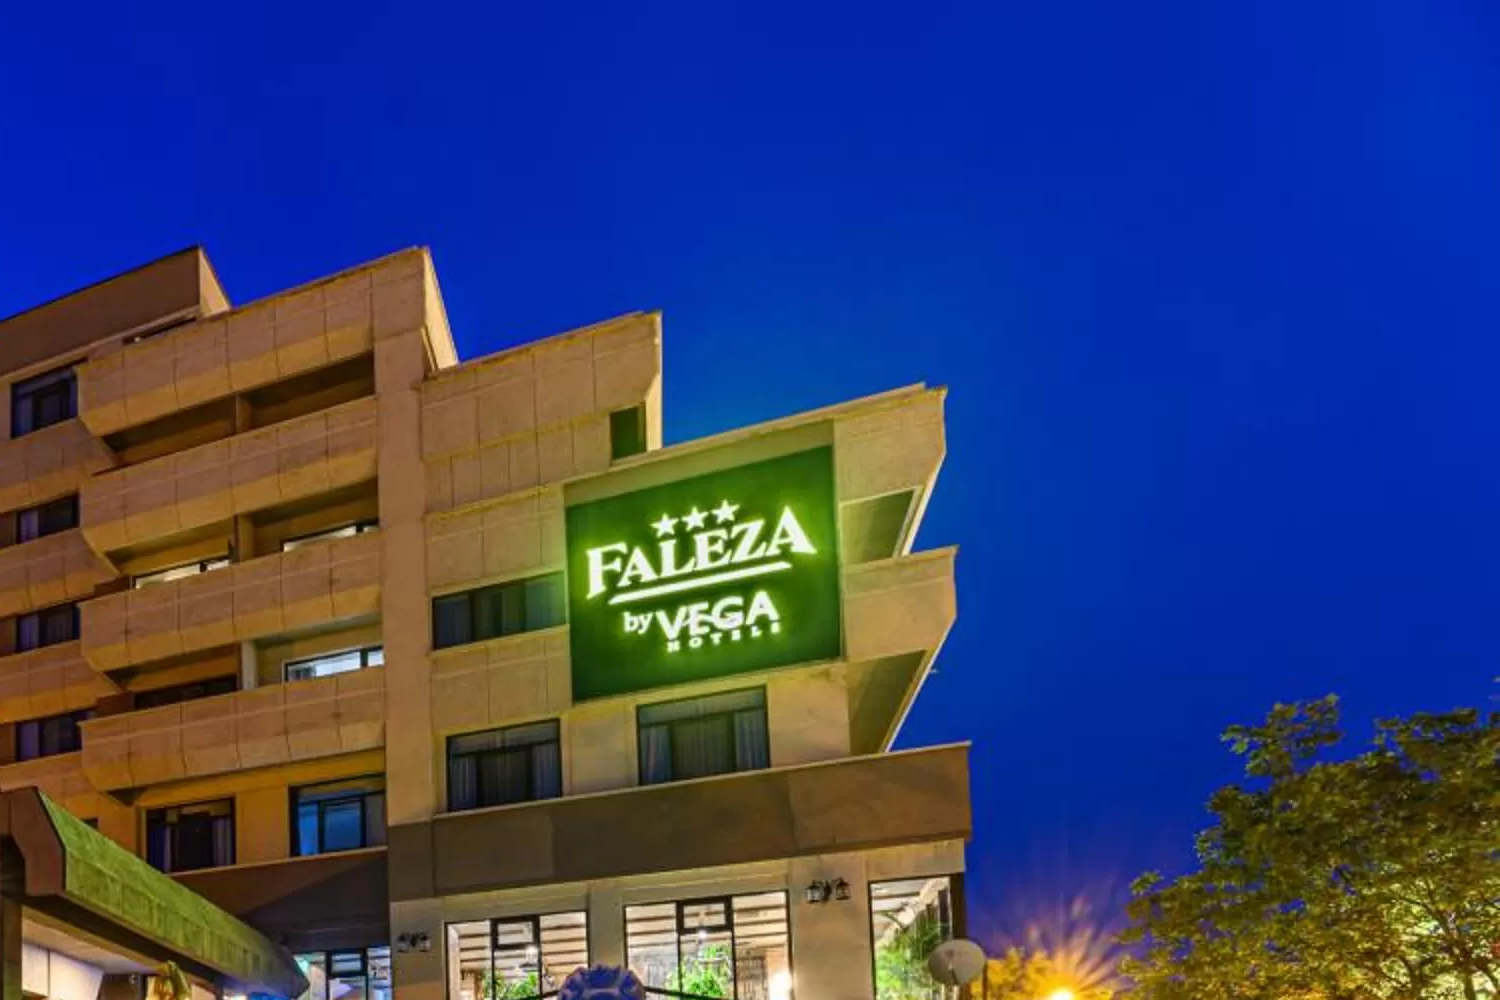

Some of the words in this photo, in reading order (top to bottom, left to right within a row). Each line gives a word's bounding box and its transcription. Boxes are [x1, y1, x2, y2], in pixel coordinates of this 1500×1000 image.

[586, 504, 817, 599] FALEZA
[623, 611, 653, 635] by
[655, 590, 780, 640] VEGA
